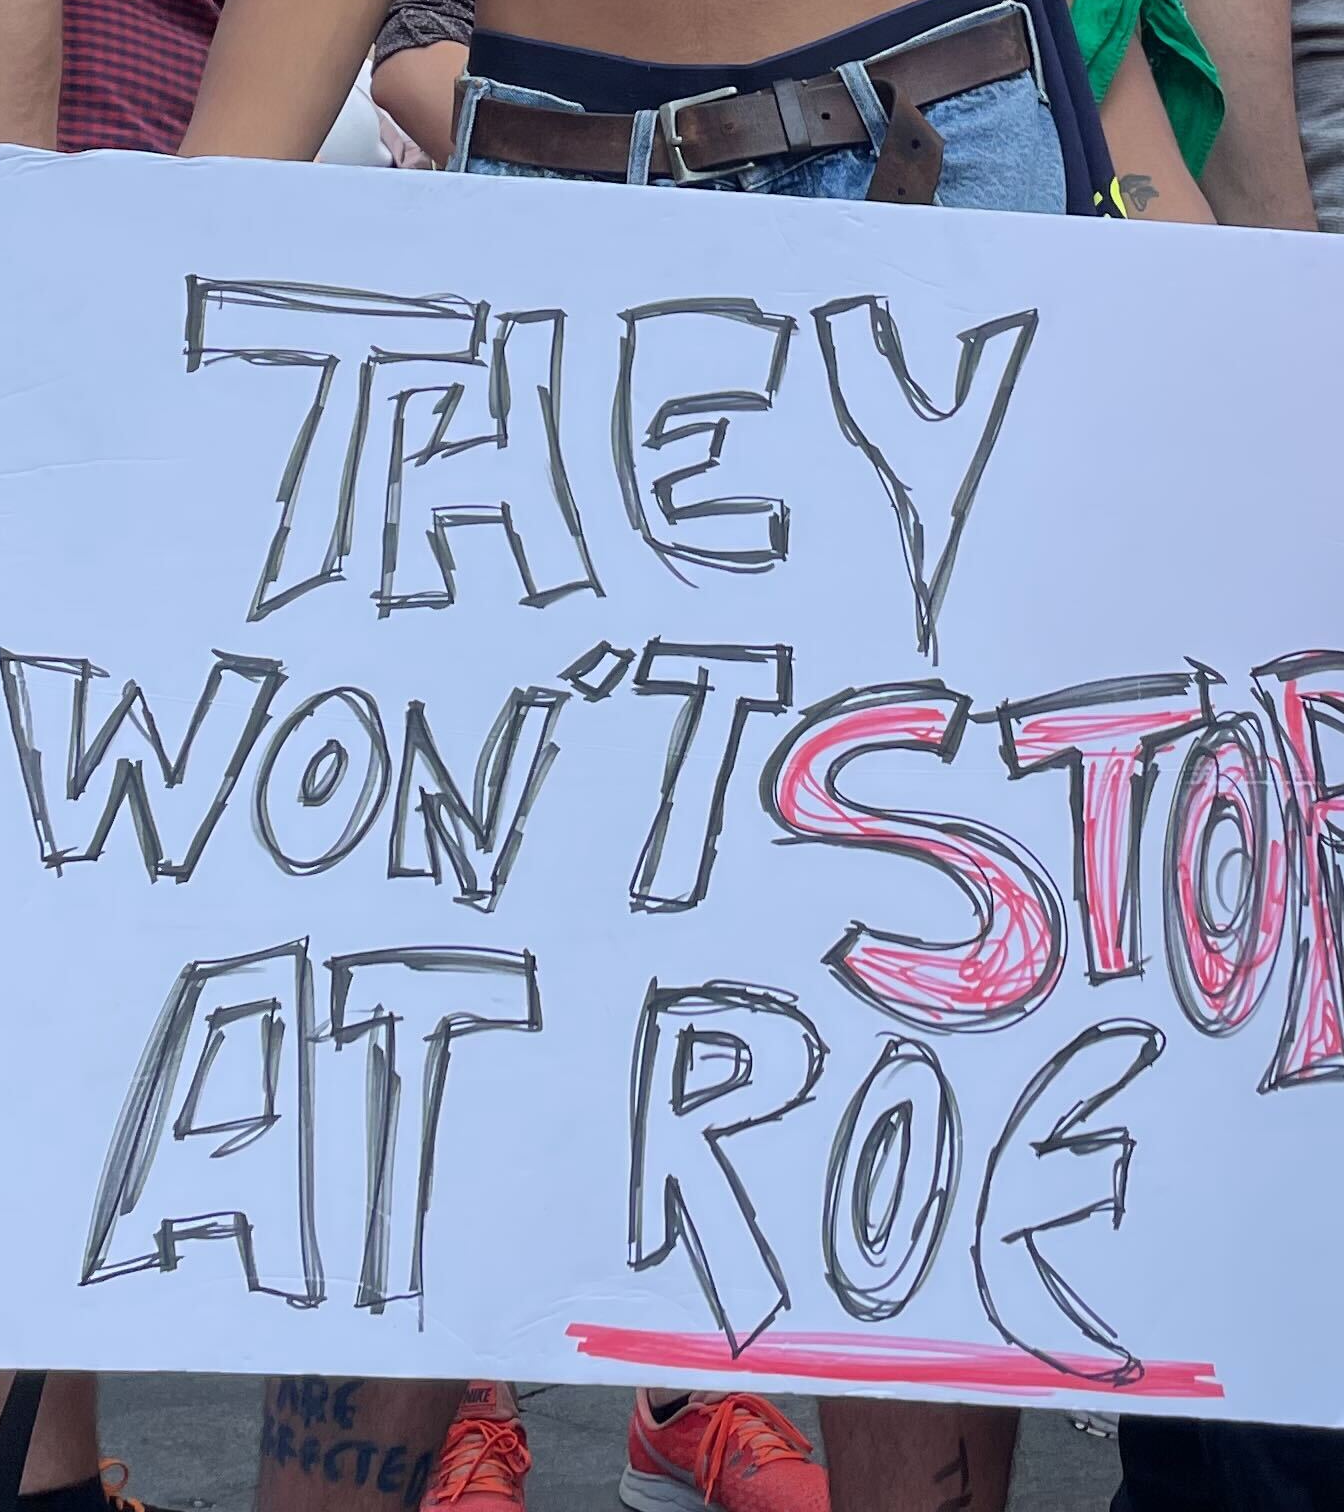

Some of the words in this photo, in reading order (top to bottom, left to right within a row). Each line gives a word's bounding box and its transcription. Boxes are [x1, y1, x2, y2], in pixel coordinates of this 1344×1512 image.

[185, 273, 1038, 665] THEY
[78, 935, 543, 1331] AT
[625, 978, 1166, 1386] ROE
[464, 1388, 492, 1403] NIKE
